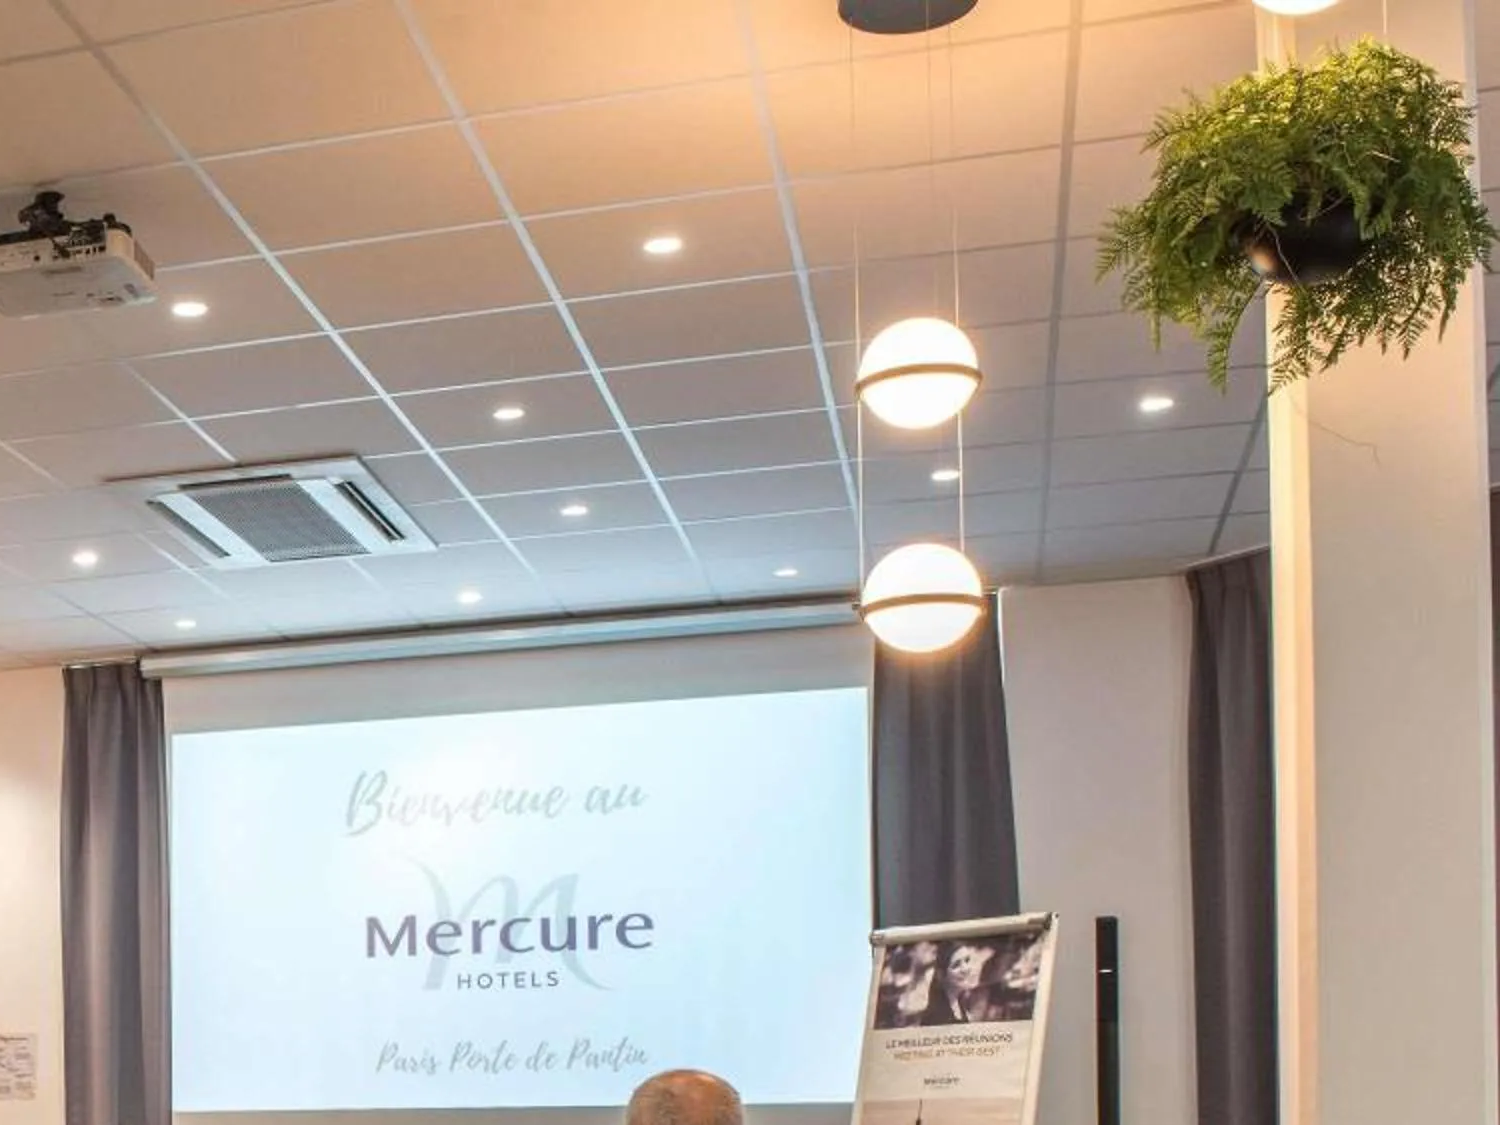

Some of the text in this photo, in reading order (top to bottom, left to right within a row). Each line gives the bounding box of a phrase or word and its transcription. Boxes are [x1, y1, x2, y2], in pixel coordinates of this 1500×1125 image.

[346, 769, 648, 837] Bienvenue au
[365, 912, 655, 959] Mercure
[456, 971, 560, 990] HOTELS
[375, 1036, 649, 1076] Paris Porte de Pantin
